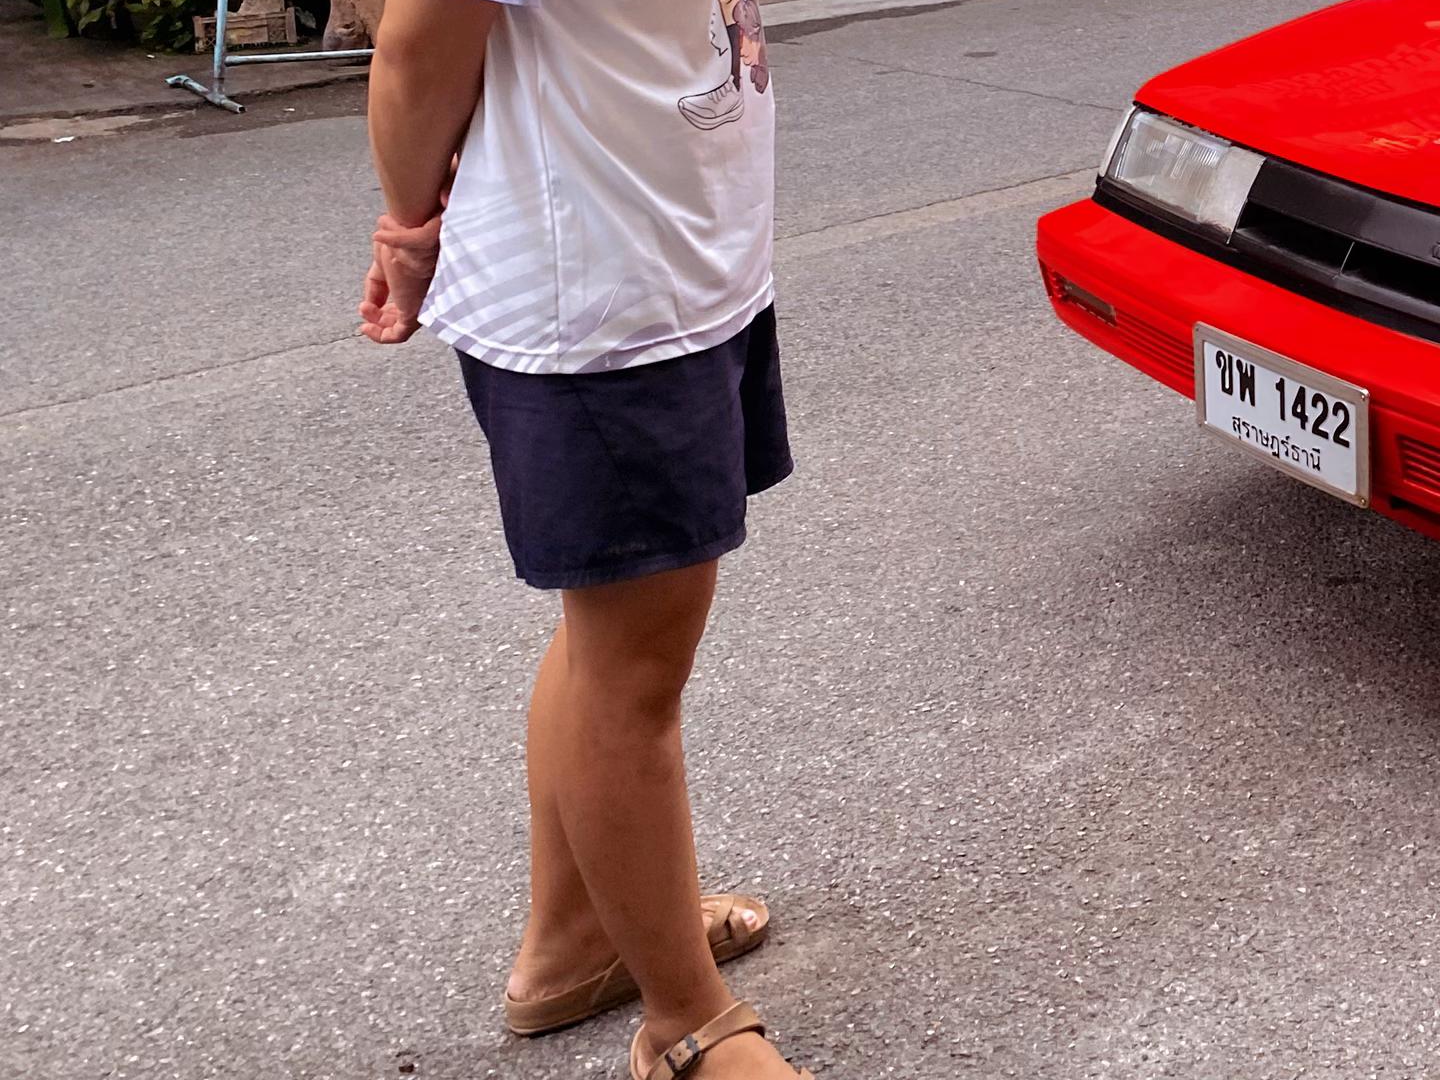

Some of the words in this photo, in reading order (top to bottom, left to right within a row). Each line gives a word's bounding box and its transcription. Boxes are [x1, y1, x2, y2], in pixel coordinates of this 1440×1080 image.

[1215, 349, 1256, 407] ขพ
[1275, 376, 1350, 449] 1422
[1231, 415, 1321, 471] สุราษฎร์ธานี
